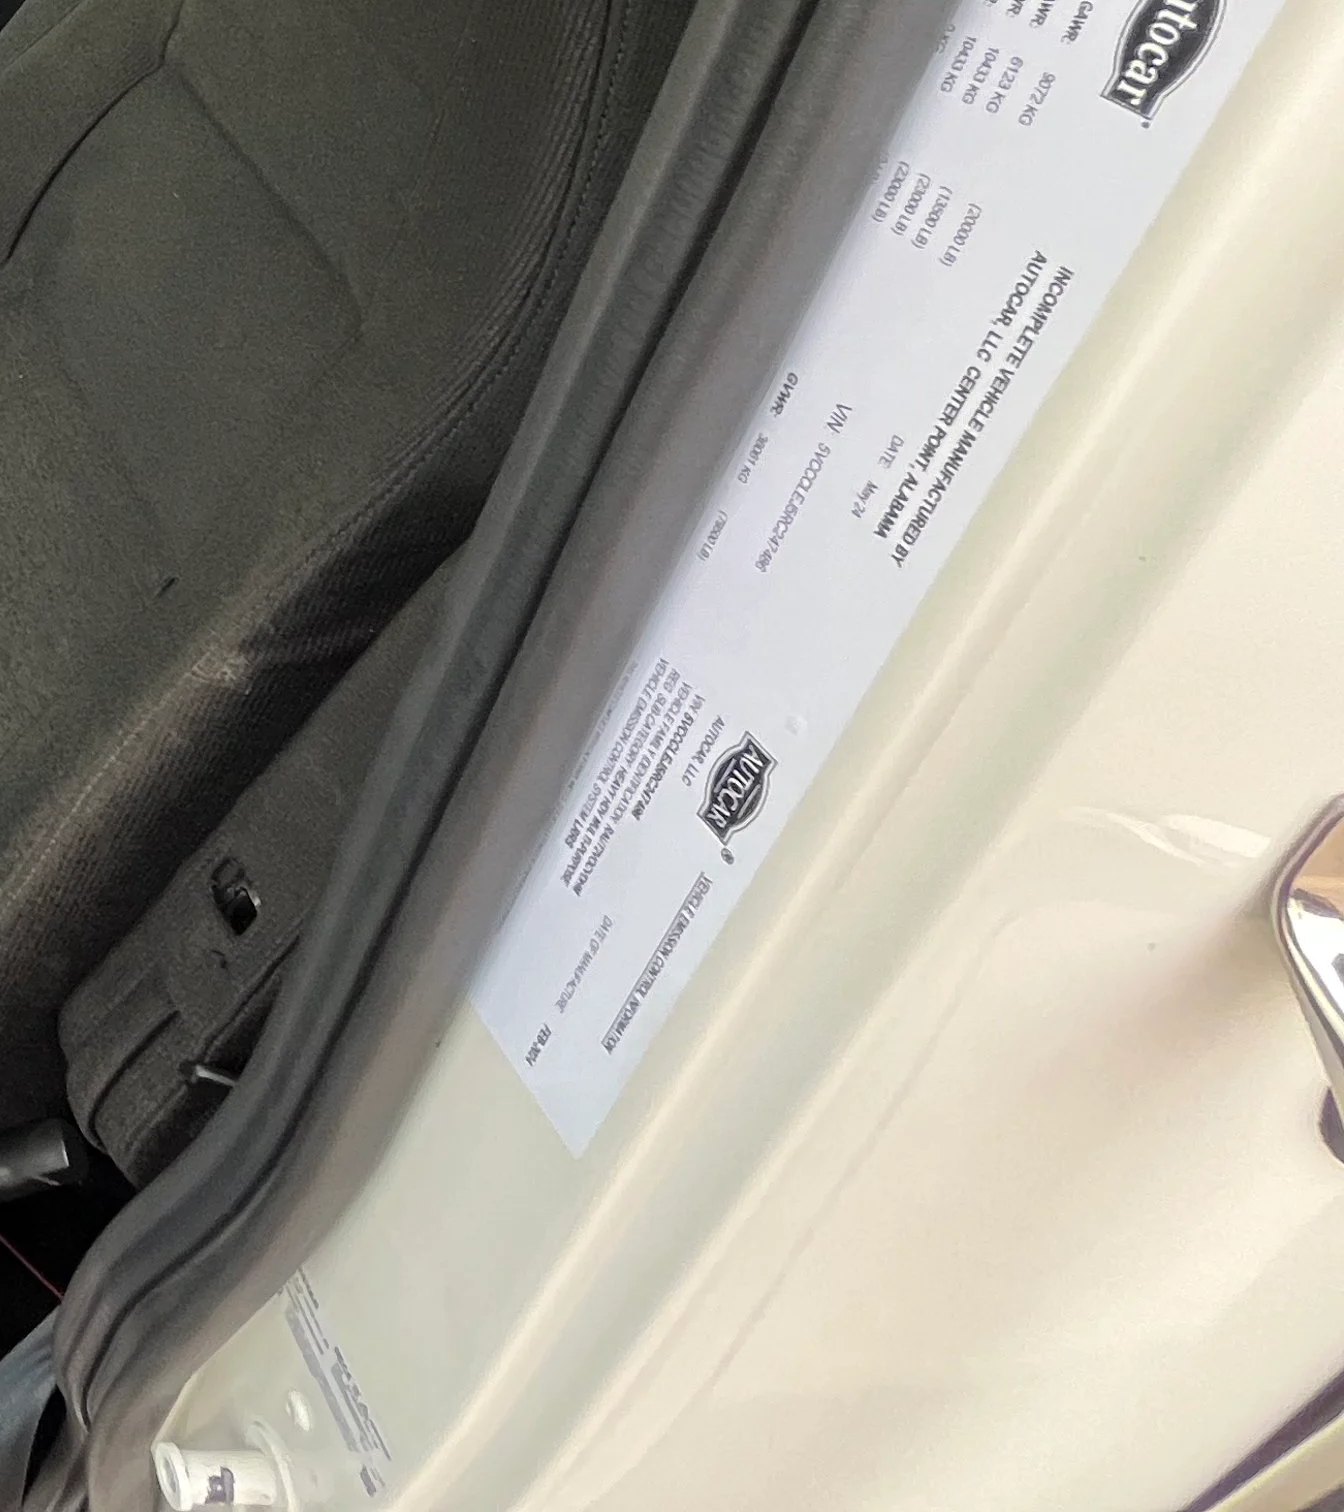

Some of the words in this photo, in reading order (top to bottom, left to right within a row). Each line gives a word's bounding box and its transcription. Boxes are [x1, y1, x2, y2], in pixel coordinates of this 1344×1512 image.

[951, 36, 977, 72] 10433
[972, 47, 1000, 84] 10433
[940, 71, 958, 93] KG
[997, 56, 1024, 91] 6123
[1030, 72, 1056, 105] 9072
[962, 83, 980, 105] KG
[986, 91, 1006, 114] KG
[1018, 104, 1038, 126] KG
[883, 160, 910, 202] (23000
[904, 173, 931, 216] (23000
[870, 201, 891, 223] LB)
[924, 185, 953, 229] (13500
[953, 203, 982, 246] (20000
[890, 214, 912, 236] LB)
[910, 227, 932, 250] LB)
[938, 245, 961, 267] LB)
[992, 249, 1048, 327] AUTOCAR,
[1006, 266, 1074, 369] INCOMPLETE
[976, 330, 1003, 363] LLC
[938, 366, 982, 427] CENTER
[968, 368, 1015, 432] VEHICLE
[909, 424, 948, 472] POINT,
[737, 464, 752, 484] KG
[902, 429, 976, 546] MANUFACTURED
[851, 501, 866, 519] 24
[856, 480, 879, 505] May
[873, 471, 918, 539] ALABAMA
[890, 543, 909, 568] BY
[618, 696, 648, 745] EMISSION
[607, 765, 628, 798] HEAVY
[681, 762, 699, 787] LLC
[704, 744, 767, 829] AUTOCAR
[578, 782, 602, 822] SYSTEM
[594, 914, 613, 942] DATE
[656, 911, 692, 959] EMISSION
[632, 954, 667, 999] CONTROL
